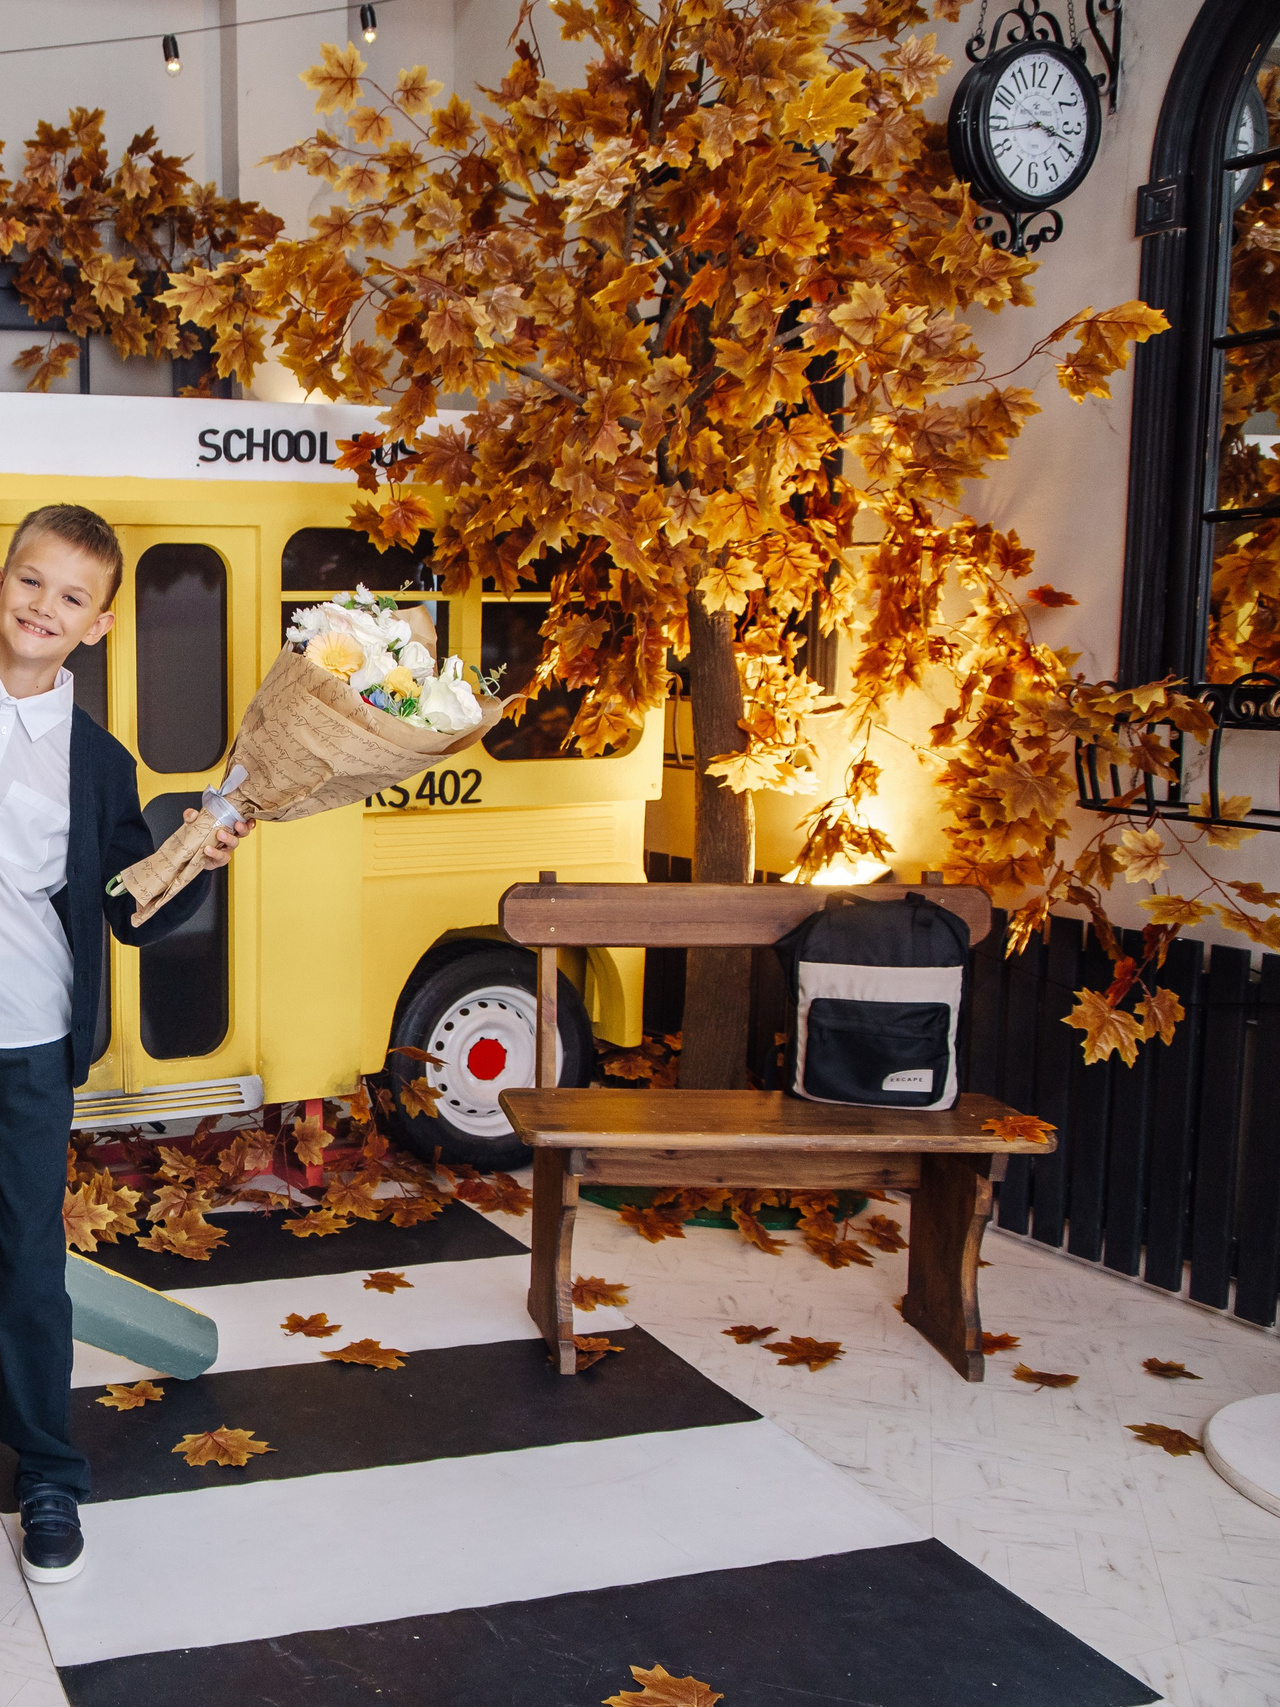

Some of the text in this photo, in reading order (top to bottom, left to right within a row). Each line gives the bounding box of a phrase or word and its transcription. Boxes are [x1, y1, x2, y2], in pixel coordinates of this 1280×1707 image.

[1010, 66, 1029, 94] 11
[1030, 61, 1049, 89] 12
[1051, 73, 1064, 96] 1
[995, 85, 1016, 111] 10
[1058, 92, 1078, 114] 2
[989, 115, 1009, 131] 9
[1062, 120, 1083, 136] 3
[993, 138, 1013, 159] 8
[1058, 142, 1076, 163] 4
[1009, 155, 1023, 178] 7
[1027, 161, 1039, 189] 6
[1043, 156, 1060, 182] 5
[198, 427, 337, 465] SCHOOL
[362, 739, 379, 754] Love
[415, 769, 482, 805] 402
